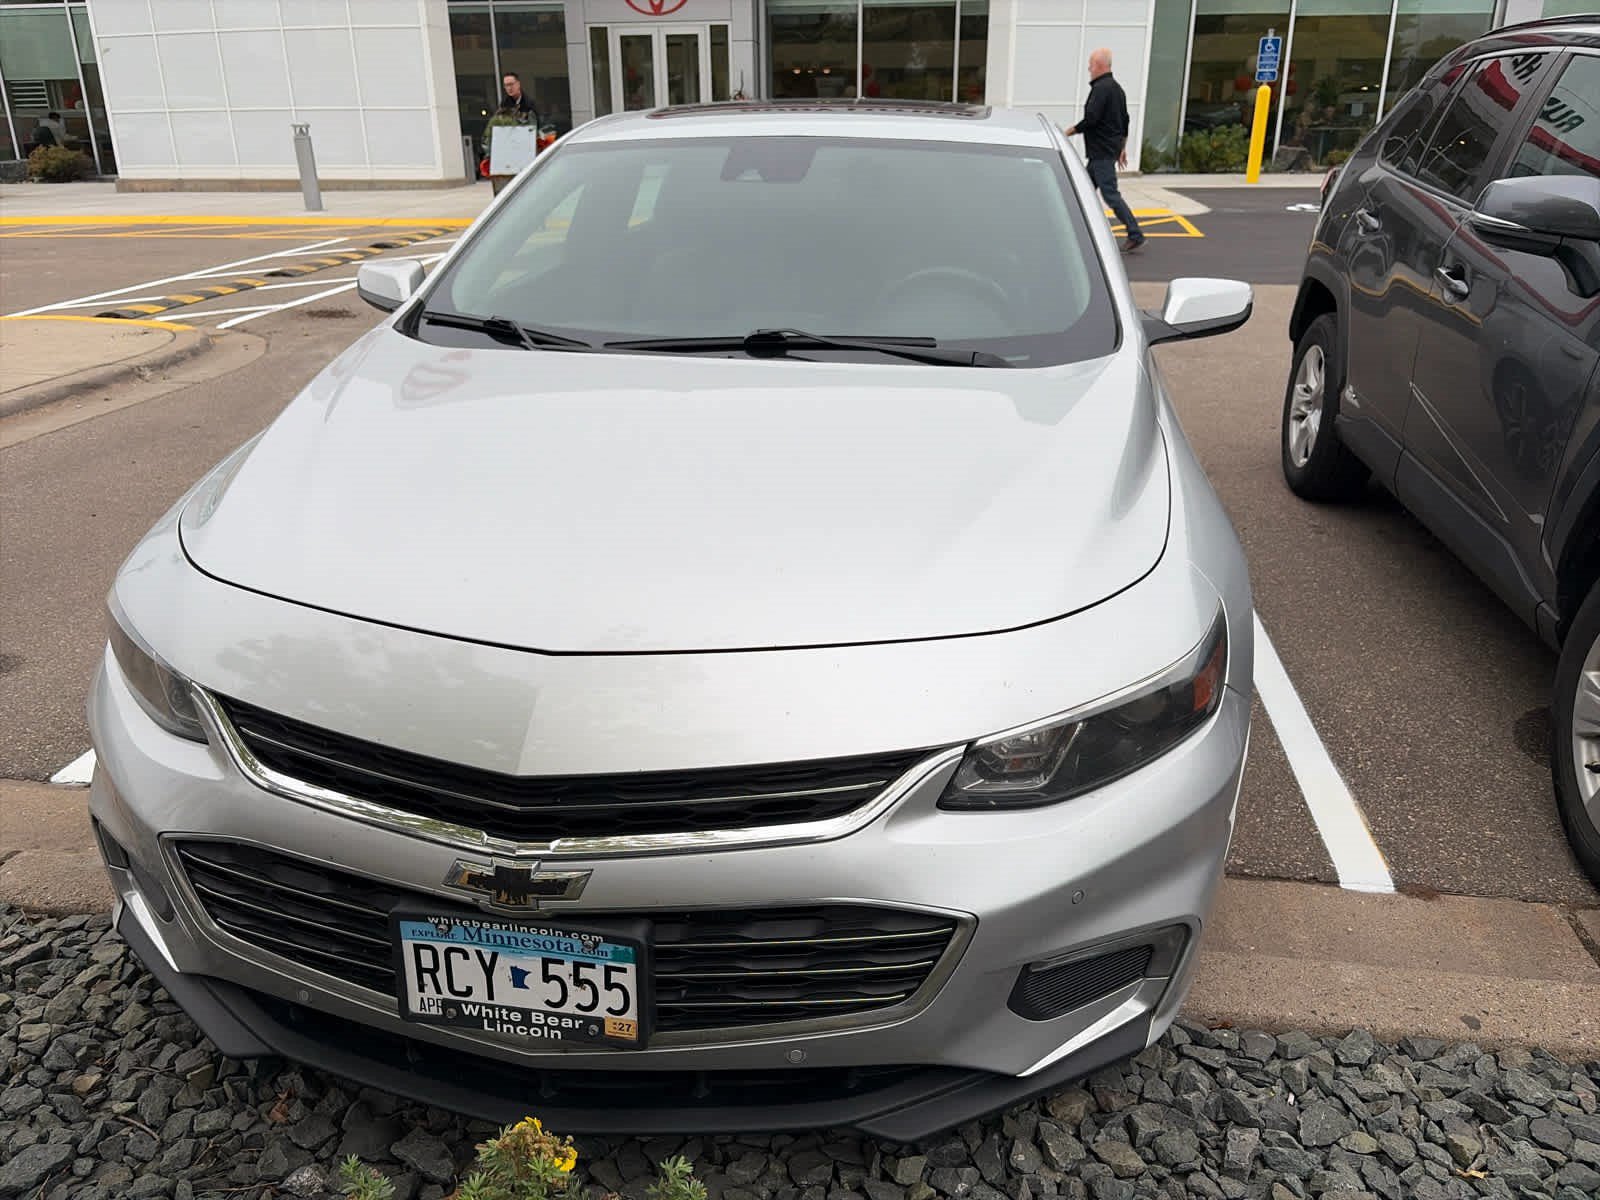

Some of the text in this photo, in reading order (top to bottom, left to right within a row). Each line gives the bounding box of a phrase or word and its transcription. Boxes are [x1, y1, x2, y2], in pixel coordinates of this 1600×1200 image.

[427, 916, 604, 943] whitebearlincoln.com
[412, 943, 631, 1016] RCY 555
[461, 1003, 584, 1029] White Bear
[483, 1018, 562, 1040] Lincoln
[617, 1022, 632, 1033] 27
